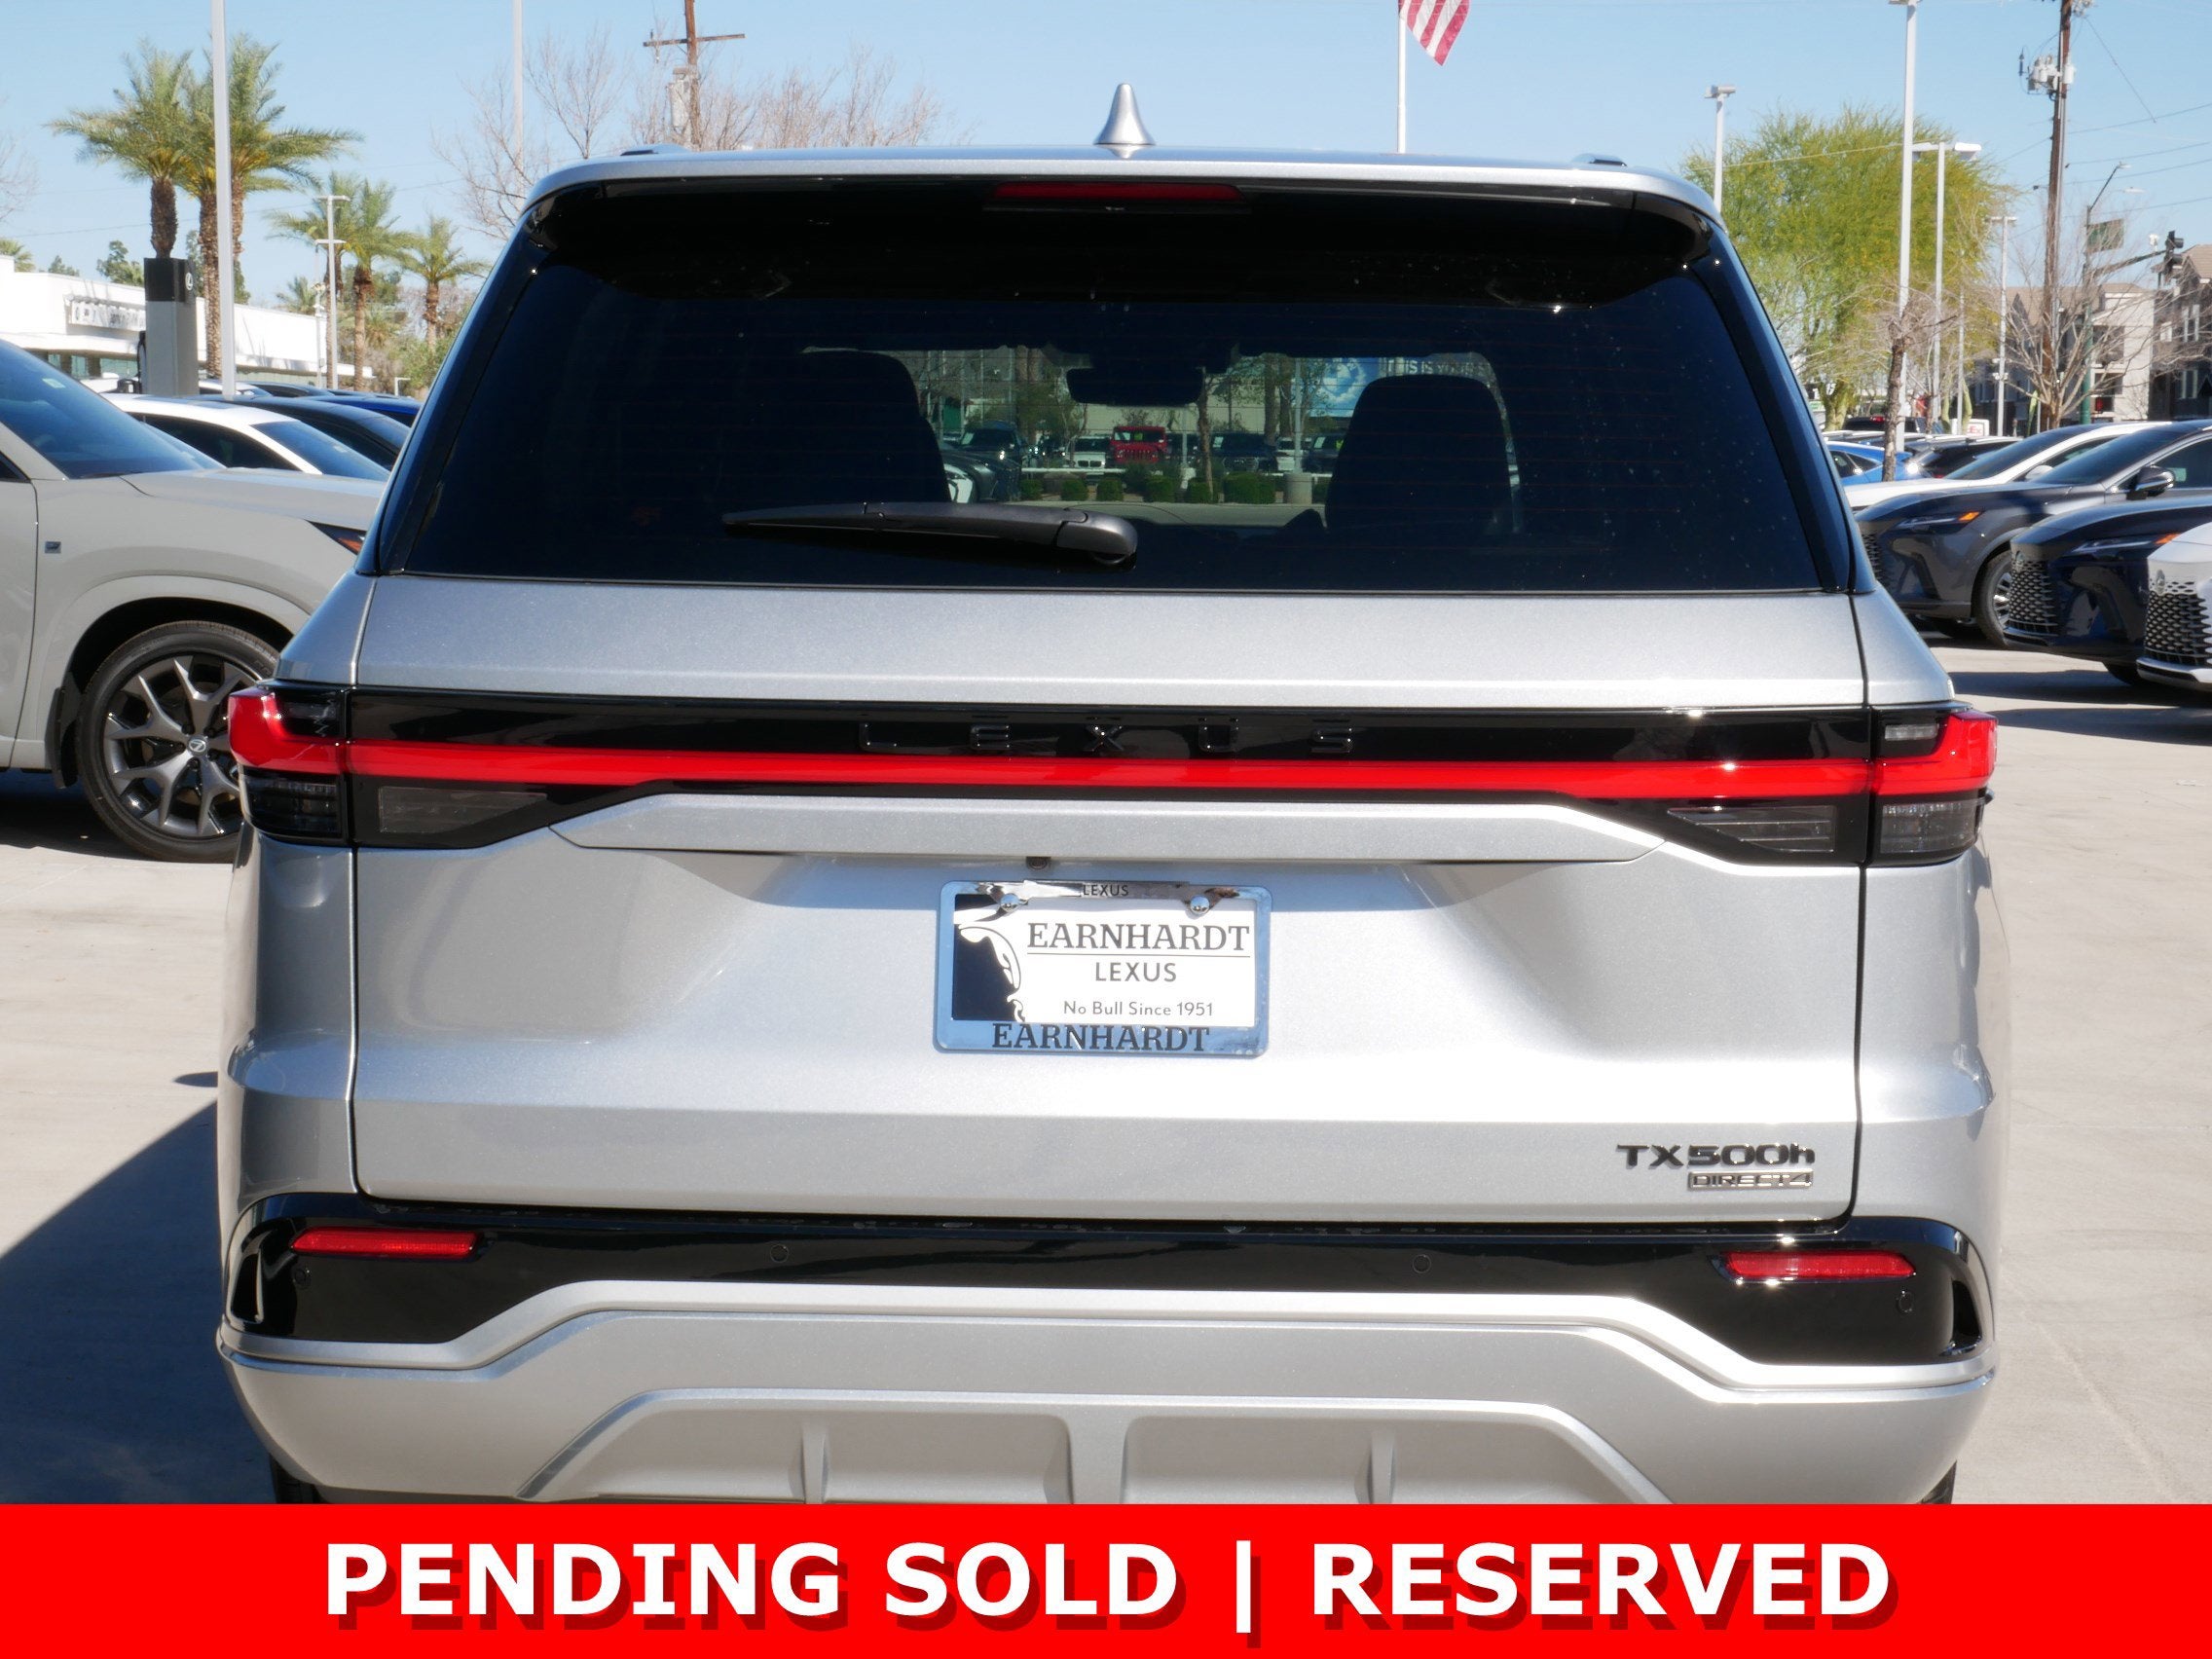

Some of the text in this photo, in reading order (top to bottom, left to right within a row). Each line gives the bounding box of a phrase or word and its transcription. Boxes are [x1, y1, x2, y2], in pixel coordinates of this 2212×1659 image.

[859, 720, 1353, 756] LEXUS
[1083, 884, 1128, 897] LEXUS
[1027, 922, 1250, 951] EARNHARDT
[1095, 962, 1177, 982] LEXUS
[1063, 1000, 1213, 1016] No Bull Since 1951
[992, 1023, 1210, 1052] EARNHARDT
